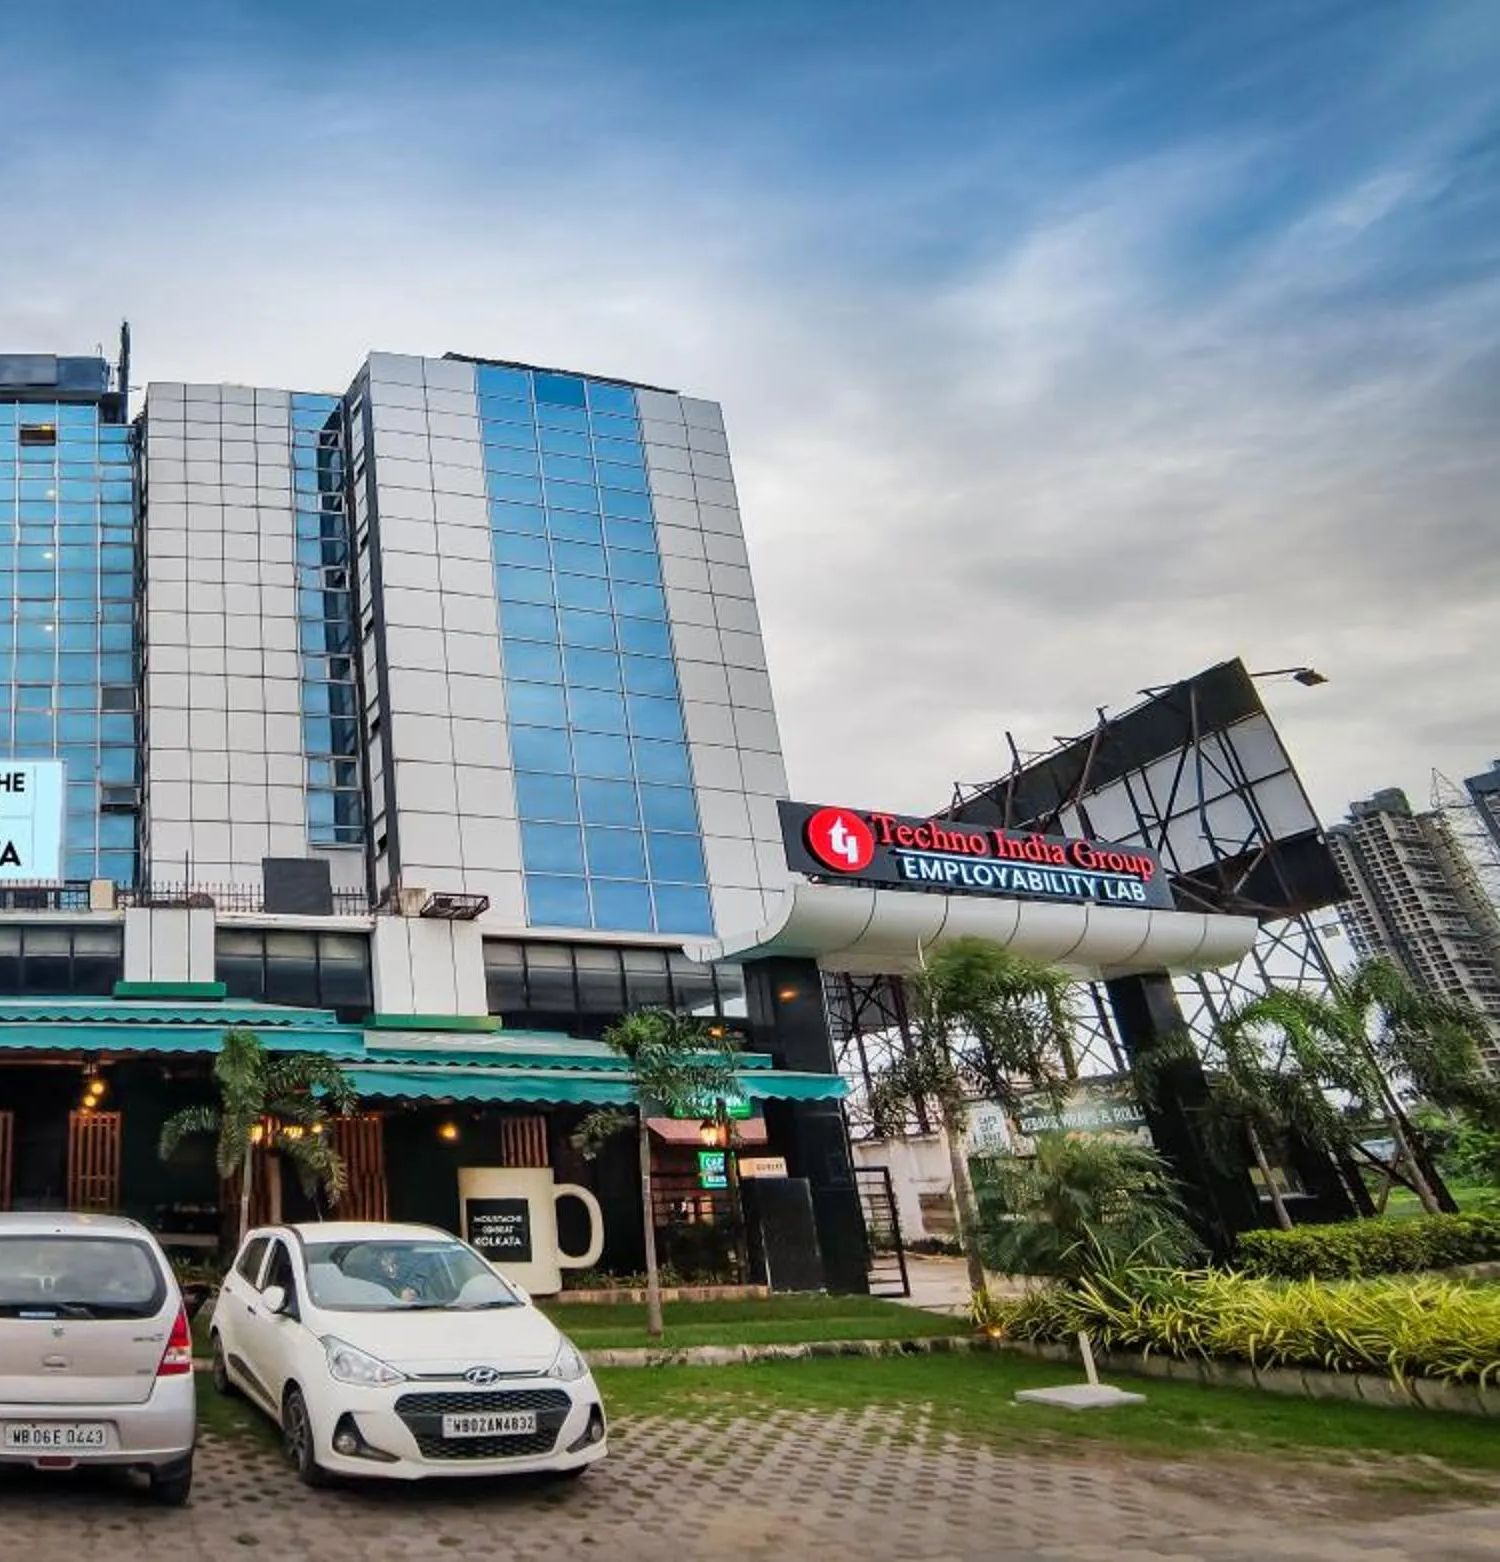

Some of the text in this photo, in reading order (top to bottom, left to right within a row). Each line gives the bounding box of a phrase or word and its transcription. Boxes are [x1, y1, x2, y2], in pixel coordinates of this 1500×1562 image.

[871, 813, 1156, 881] Techno India Group
[902, 856, 1147, 902] EMPLOYABILITY LAB
[473, 1235, 522, 1247] KOLKATA
